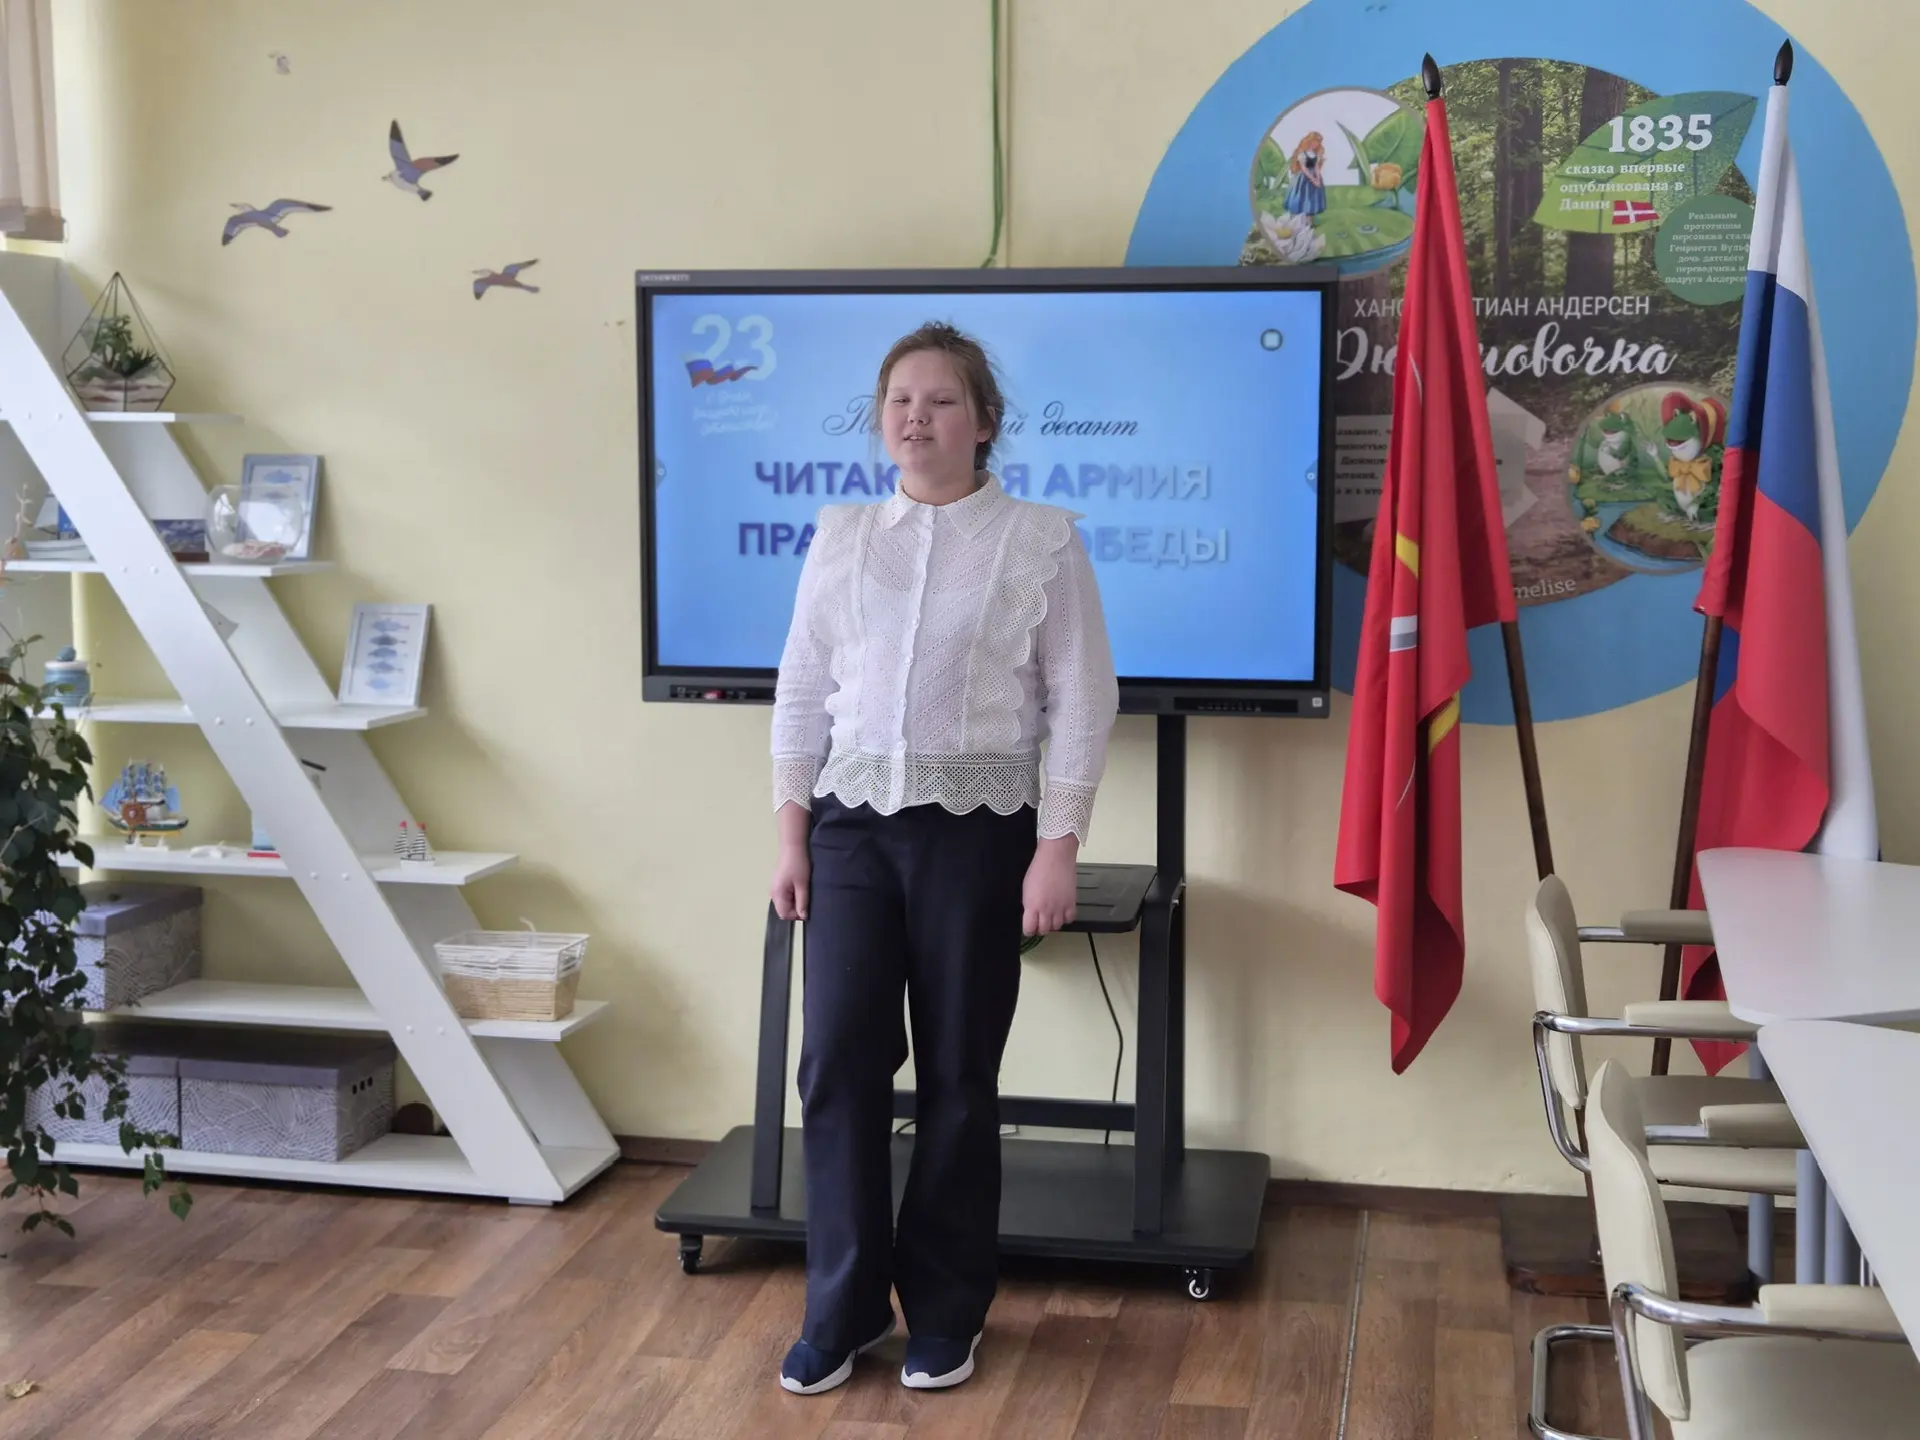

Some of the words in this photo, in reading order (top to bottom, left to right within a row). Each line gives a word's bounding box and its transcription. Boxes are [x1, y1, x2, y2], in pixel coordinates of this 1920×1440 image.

[1608, 114, 1713, 153] 1835
[1565, 165, 1614, 175] сказка
[1620, 162, 1686, 177] впервые
[1559, 180, 1668, 196] опубликована
[1674, 181, 1684, 191] в
[1559, 198, 1611, 212] Дании
[1535, 296, 1650, 319] АНДЕРСЕН
[690, 313, 778, 381] 23
[1040, 401, 1139, 437] десант
[1042, 463, 1212, 500] АРМИЯ
